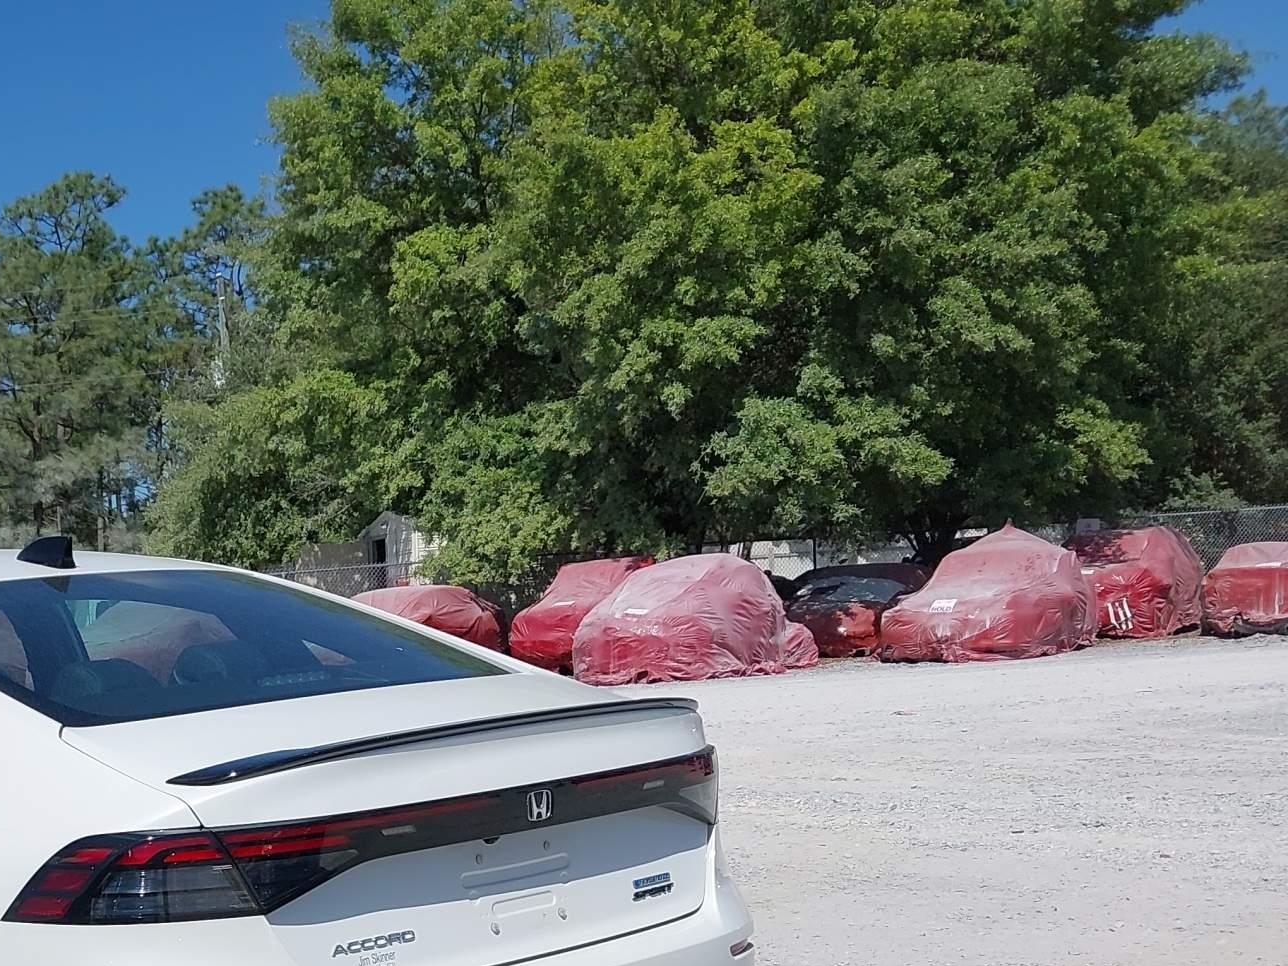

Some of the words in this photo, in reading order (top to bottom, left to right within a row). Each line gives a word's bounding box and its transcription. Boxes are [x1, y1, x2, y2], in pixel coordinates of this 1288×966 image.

[632, 882, 674, 902] SPORT
[332, 930, 416, 958] ACCORD
[359, 956, 370, 966] Jim
[371, 952, 396, 964] Skinner
